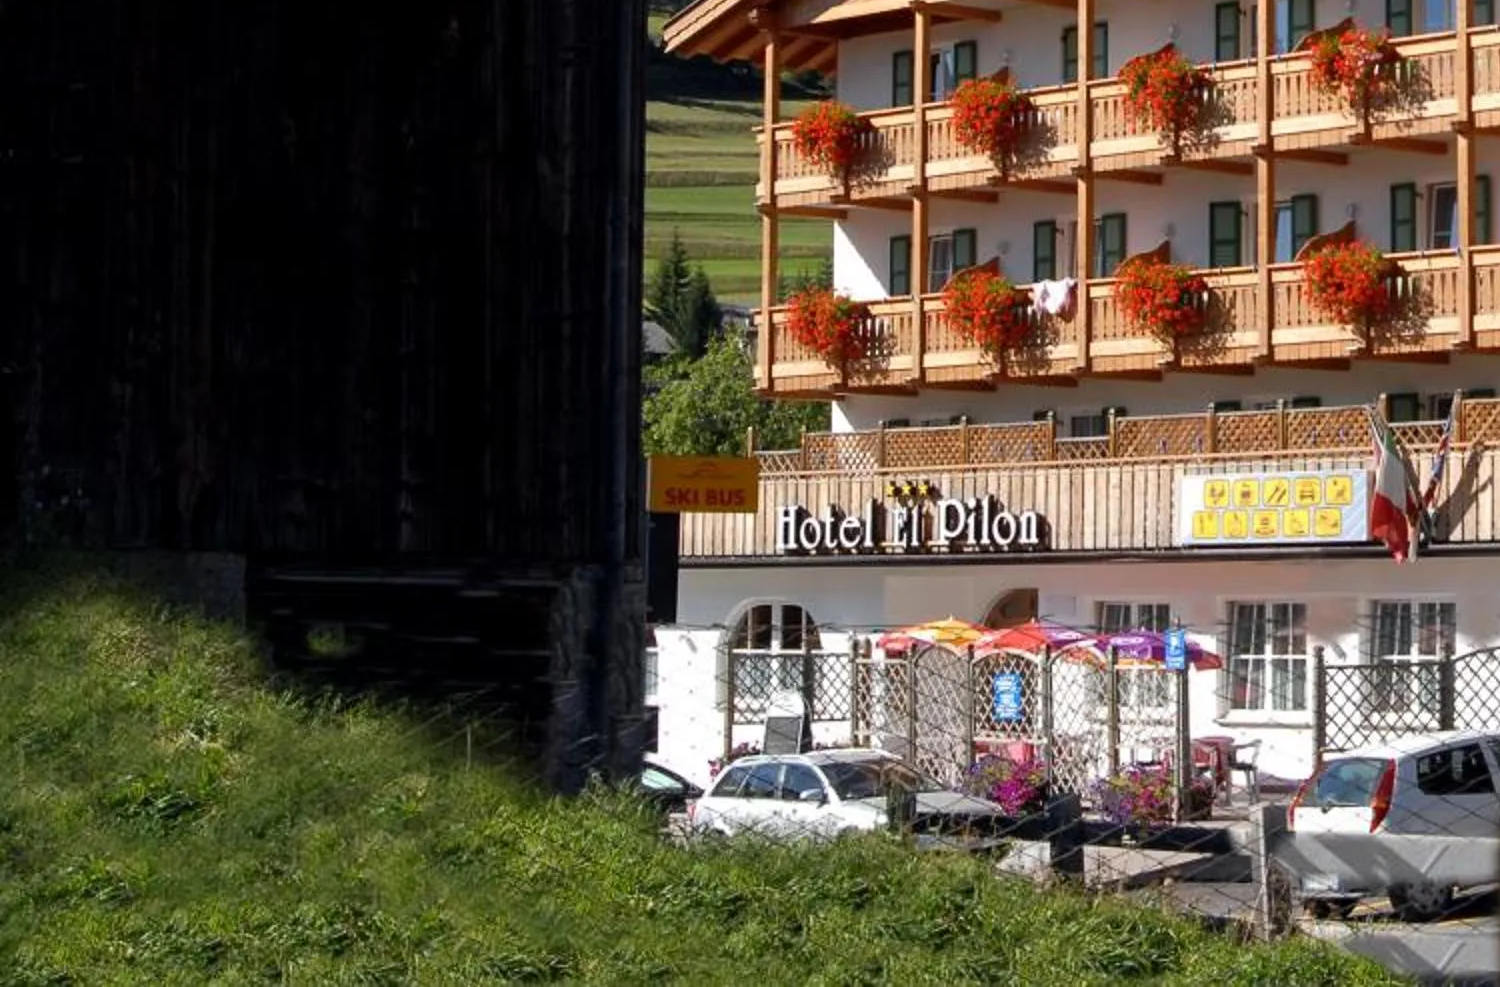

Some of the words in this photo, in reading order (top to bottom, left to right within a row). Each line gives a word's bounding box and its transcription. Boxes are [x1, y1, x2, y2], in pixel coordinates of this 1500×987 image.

[664, 486, 698, 506] SKI
[705, 487, 746, 506] BUS
[775, 497, 873, 549] Hotel
[934, 495, 1039, 545] Pilon
